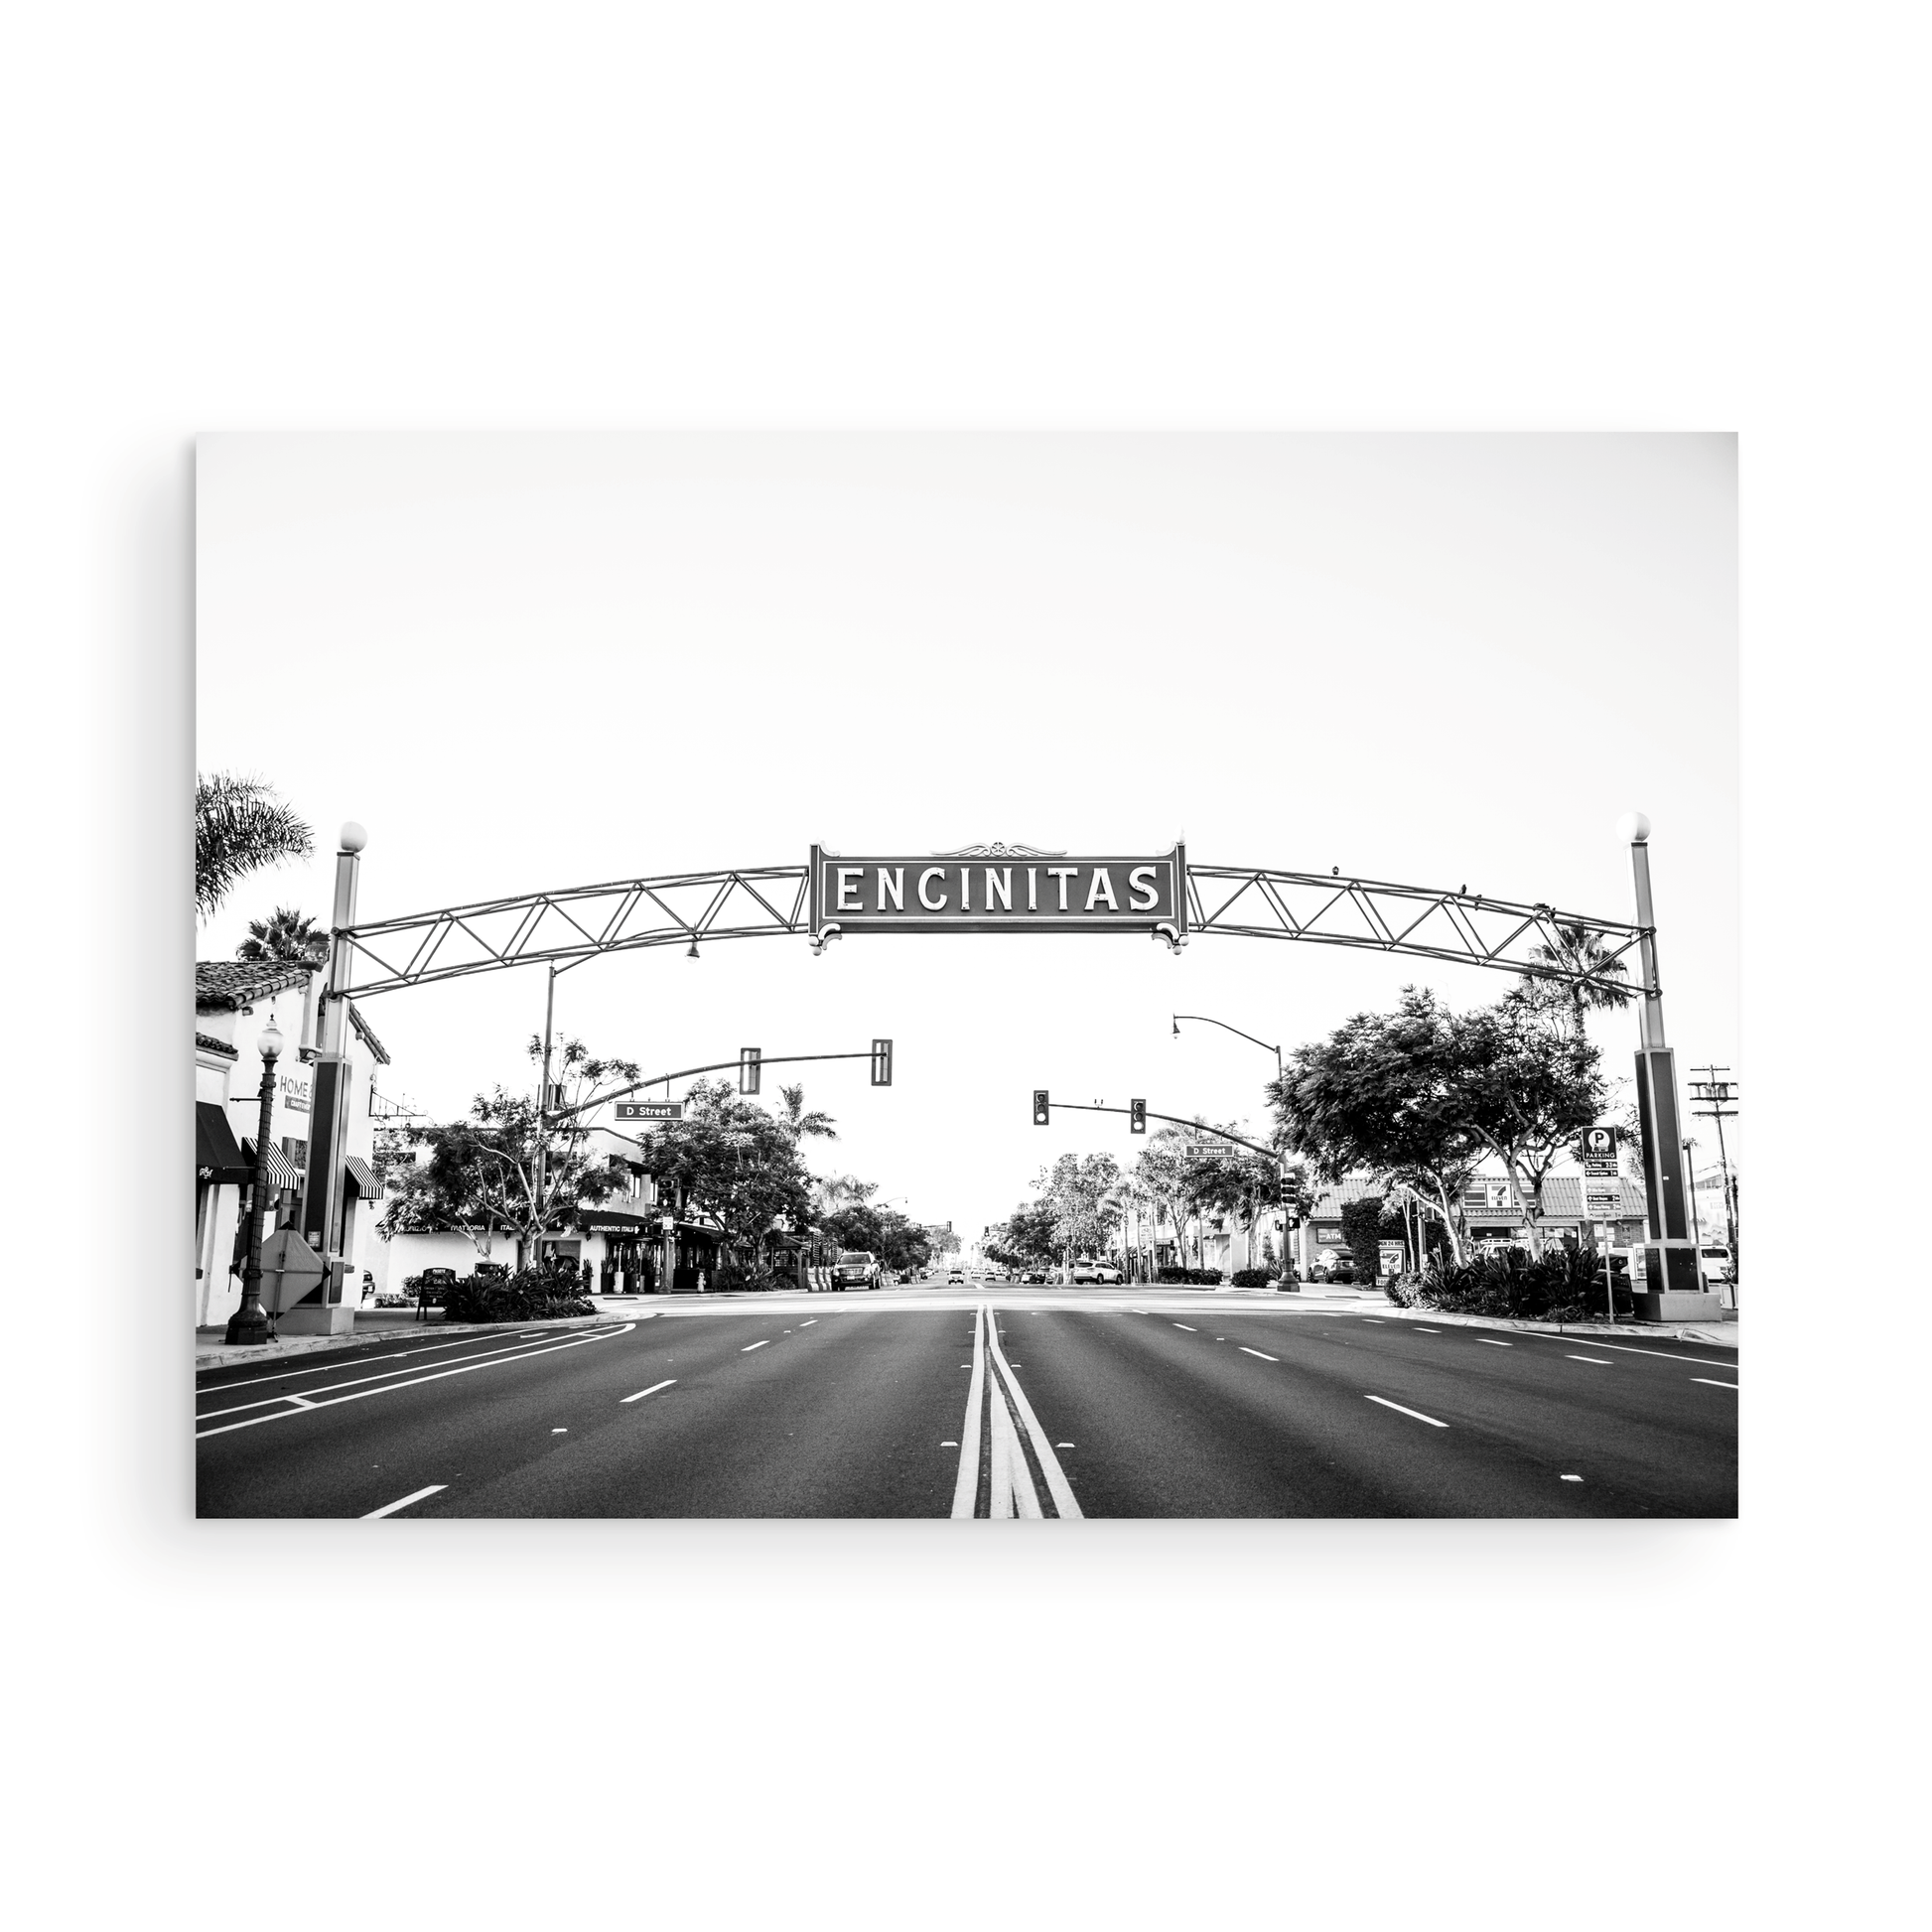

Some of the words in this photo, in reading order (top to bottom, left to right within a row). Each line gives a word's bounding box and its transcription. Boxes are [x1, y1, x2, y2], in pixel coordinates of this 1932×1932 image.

[836, 866, 1160, 912] ENCINITAS
[280, 1075, 308, 1098] HOME
[626, 1107, 634, 1116] D
[638, 1107, 672, 1116] Street
[1594, 1132, 1604, 1144] P
